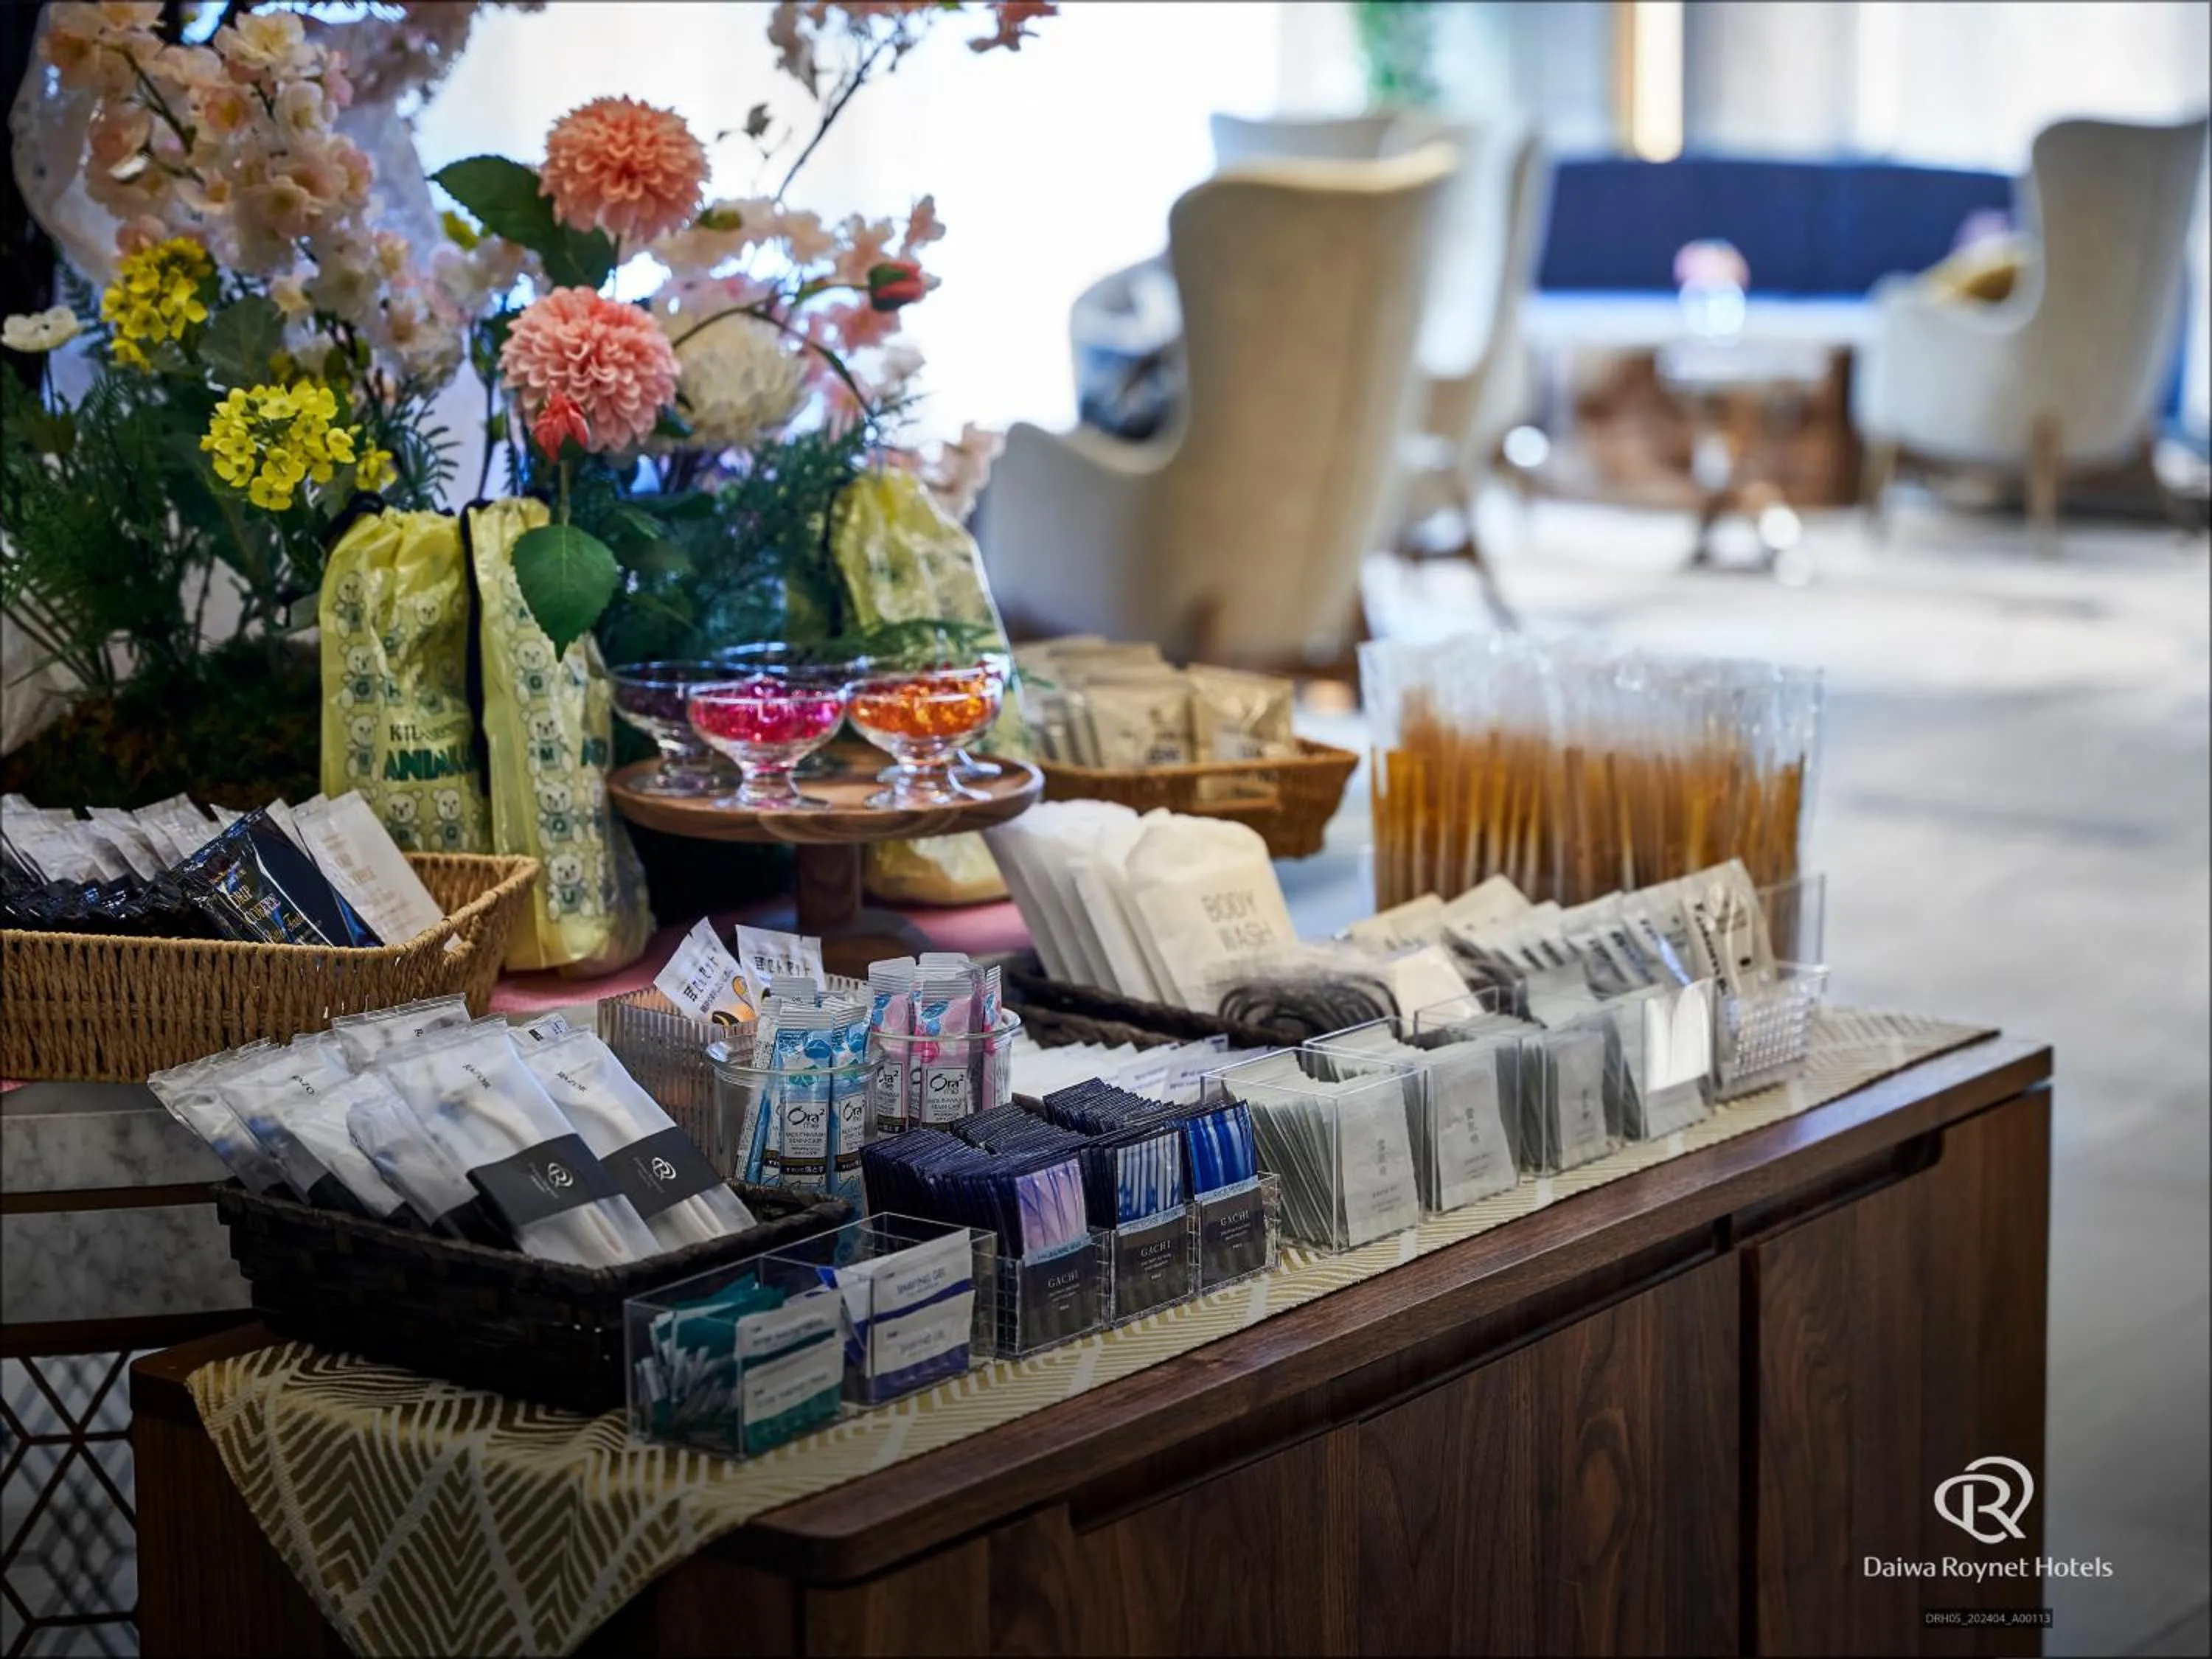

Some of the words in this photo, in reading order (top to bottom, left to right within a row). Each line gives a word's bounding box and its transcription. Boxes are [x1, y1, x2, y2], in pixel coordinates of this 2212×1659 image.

[1201, 888, 1258, 924] BODY
[1220, 1210, 1251, 1226] GACHI
[1141, 1239, 1171, 1257] GACHI
[1048, 1270, 1079, 1288] GACHI
